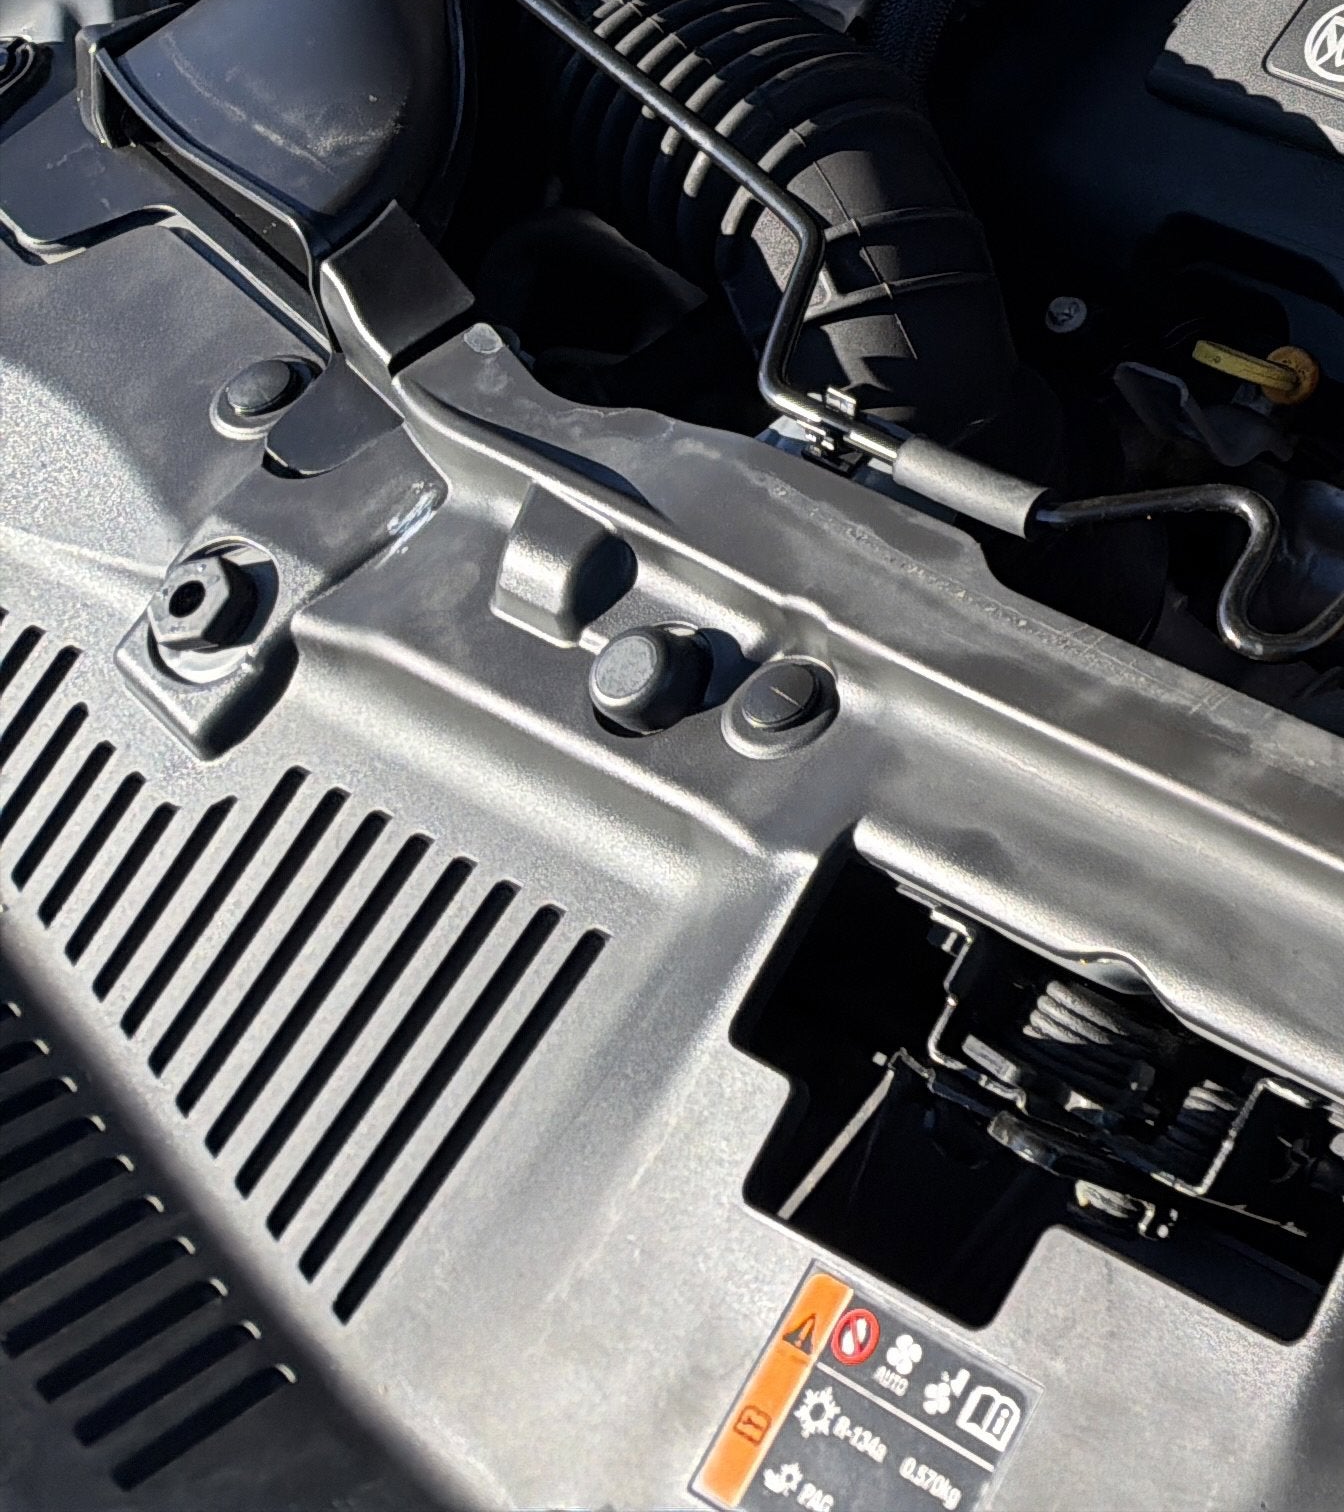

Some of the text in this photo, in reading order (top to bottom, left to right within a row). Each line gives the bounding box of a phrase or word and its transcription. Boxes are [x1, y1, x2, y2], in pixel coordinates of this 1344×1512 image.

[873, 1366, 909, 1397] AUTO
[833, 1415, 963, 1511] R-134a 0.570kg
[797, 1482, 834, 1512] PAG
